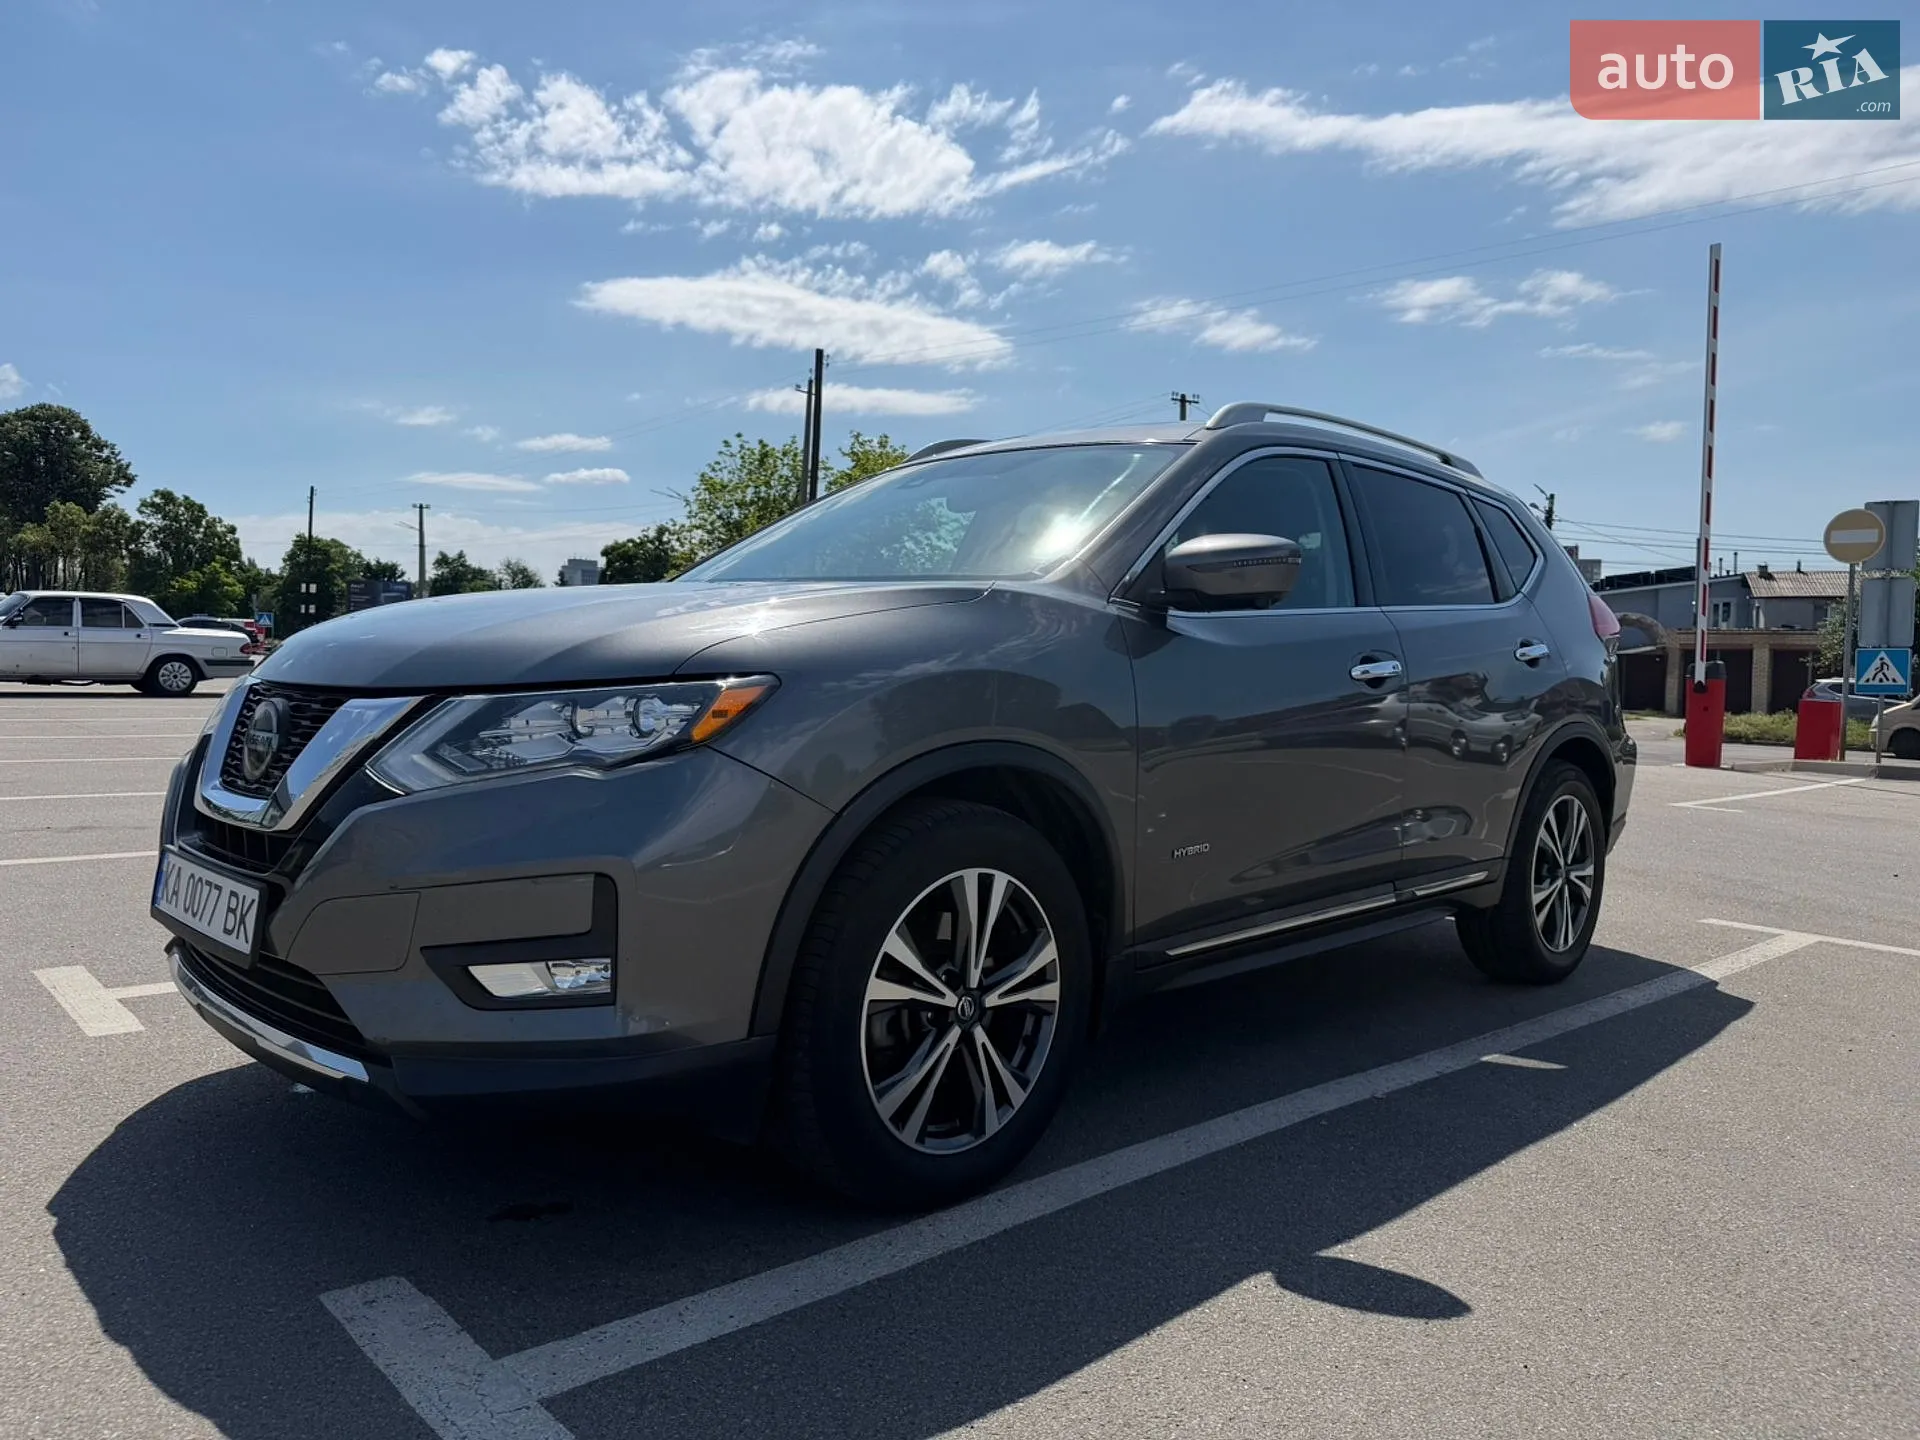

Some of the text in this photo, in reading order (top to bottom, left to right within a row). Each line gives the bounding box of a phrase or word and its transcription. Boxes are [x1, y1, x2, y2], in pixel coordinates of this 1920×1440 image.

[1174, 843, 1210, 859] HYBRID
[163, 861, 256, 944] KA 0077 BK
